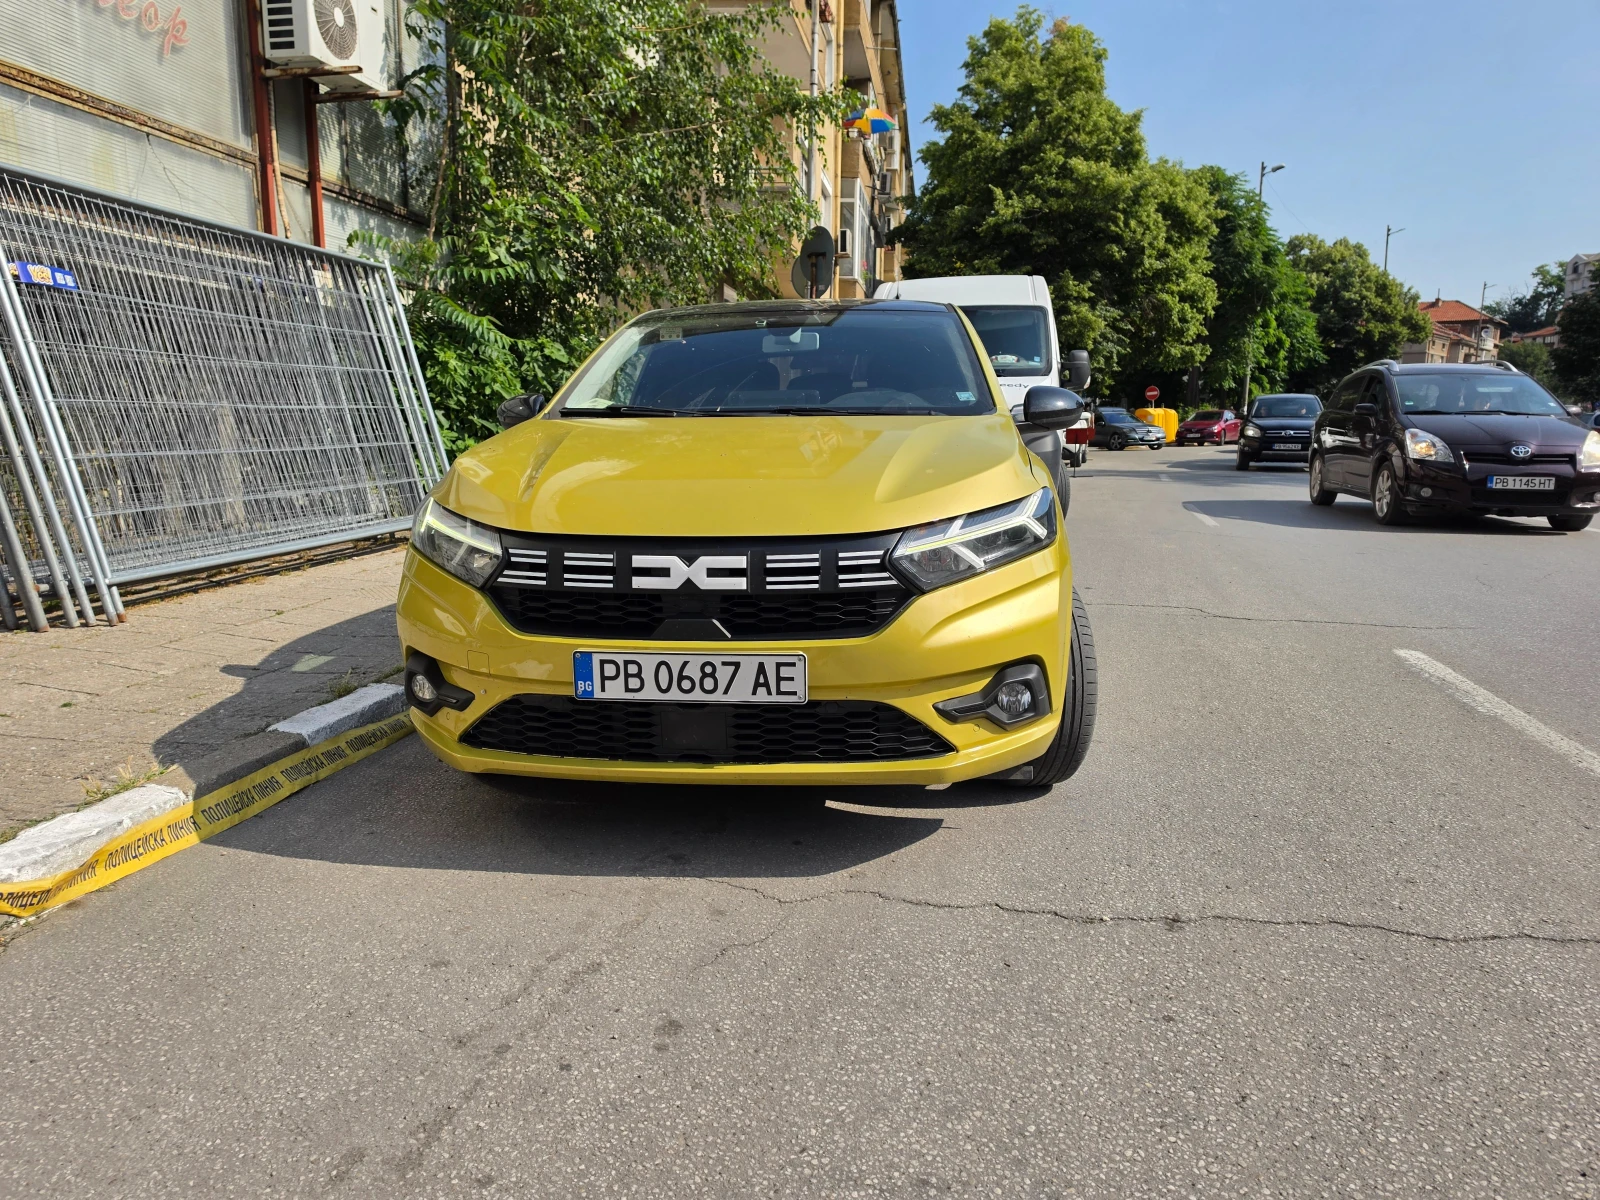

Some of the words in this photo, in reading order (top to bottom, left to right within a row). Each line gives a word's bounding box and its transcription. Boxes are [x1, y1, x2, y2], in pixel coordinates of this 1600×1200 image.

[1495, 478, 1509, 488] PB
[1512, 478, 1537, 488] 1145
[1538, 479, 1553, 488] HT
[577, 681, 593, 691] BG
[599, 658, 645, 693] PB
[654, 660, 741, 695] 0687
[751, 661, 798, 696] AE
[104, 828, 167, 871] ПОЛИЦЕЙСКА
[167, 815, 202, 844] ЛИНИЯ
[201, 787, 257, 825] ПОЛИЦЕЙСКА
[252, 775, 284, 804] ЛИНИЯ
[280, 754, 327, 784] ПОЛИЦЕЙСКА
[321, 745, 350, 766] ЛИНИЯ
